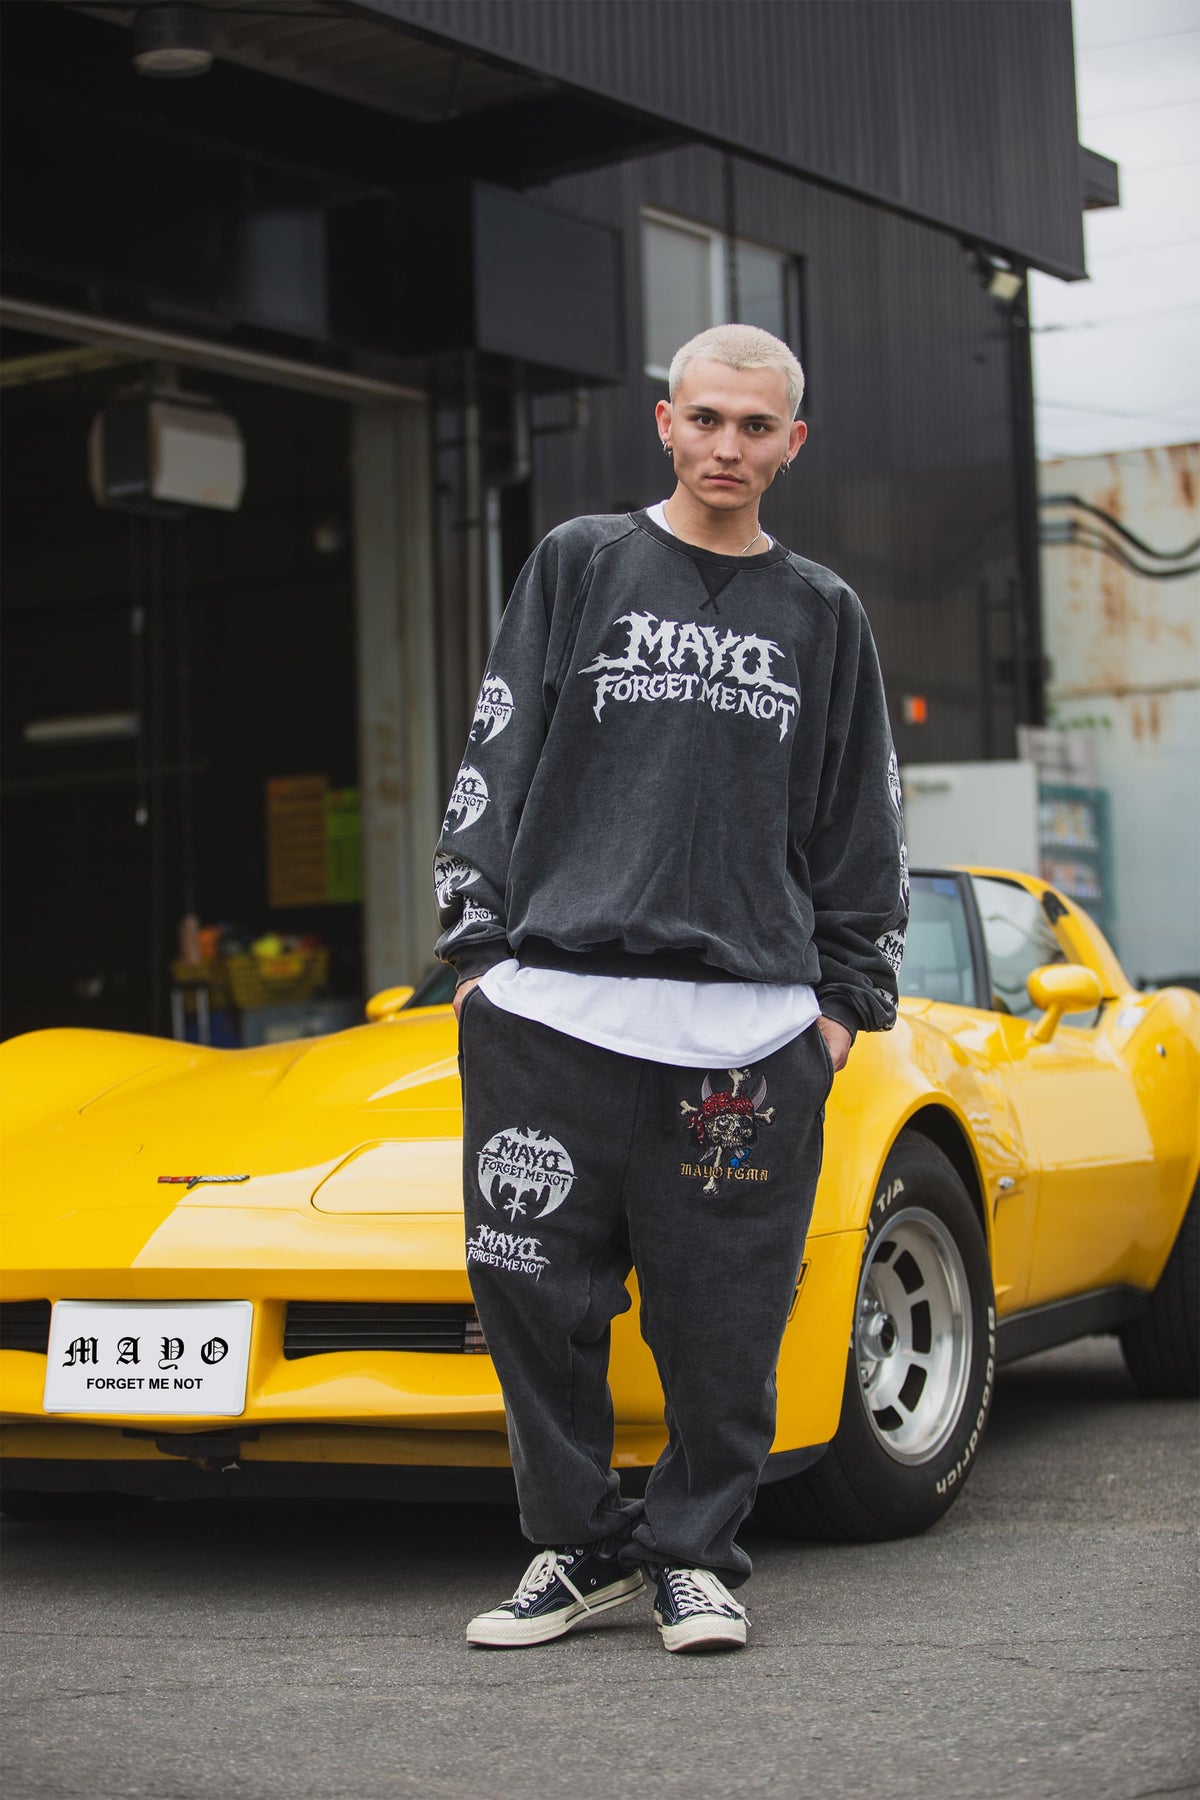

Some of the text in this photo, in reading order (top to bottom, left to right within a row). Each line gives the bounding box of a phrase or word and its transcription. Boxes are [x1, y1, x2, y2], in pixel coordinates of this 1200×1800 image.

[578, 611, 800, 708] MAYO
[593, 672, 699, 723] FORGET
[480, 1135, 574, 1177] MAYO
[481, 1158, 525, 1178] FORGET
[680, 1163, 723, 1179] MAYO
[876, 1178, 904, 1213] T/A
[466, 1224, 551, 1264] MAYO
[87, 1378, 203, 1390] FORGET ME NOT
